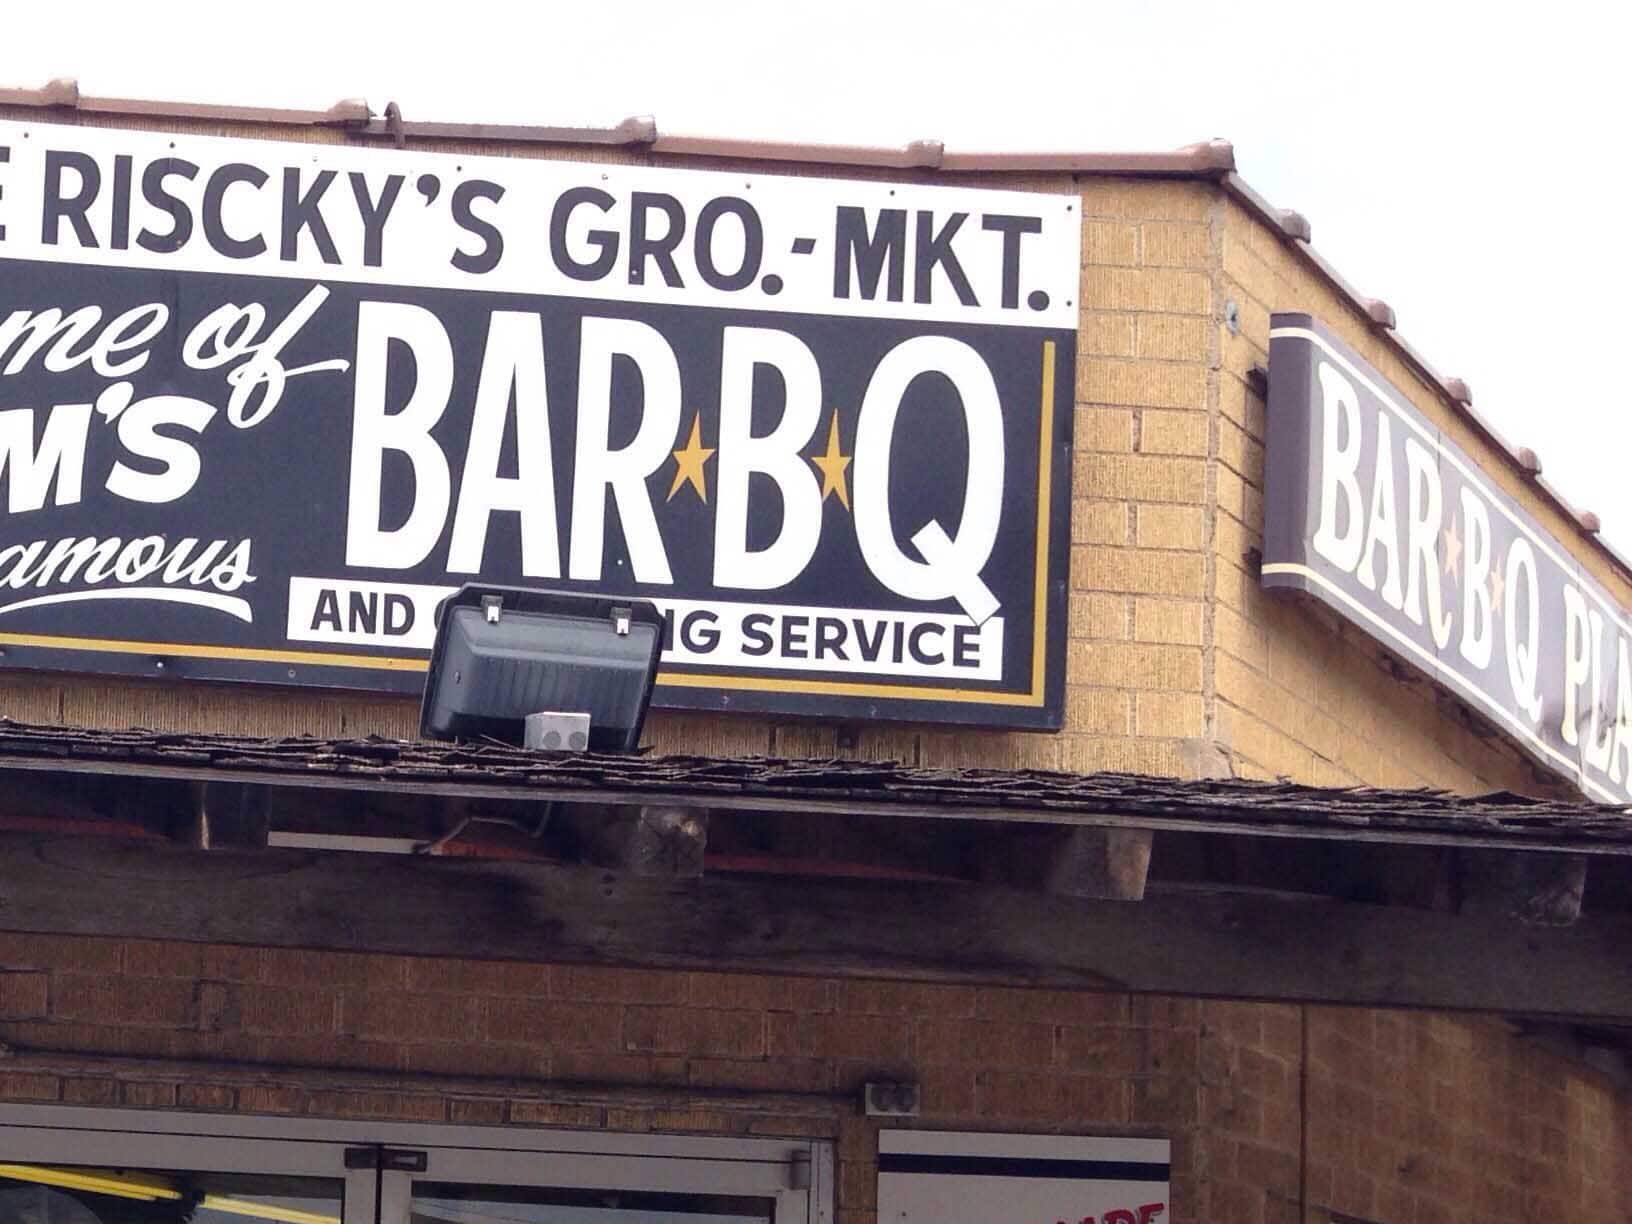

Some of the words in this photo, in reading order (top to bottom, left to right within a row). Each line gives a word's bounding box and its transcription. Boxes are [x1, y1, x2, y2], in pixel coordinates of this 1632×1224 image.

[42, 150, 506, 276] RISCKY'S
[183, 284, 350, 428] of
[310, 590, 415, 634] AND
[741, 610, 982, 668] SERVICE
